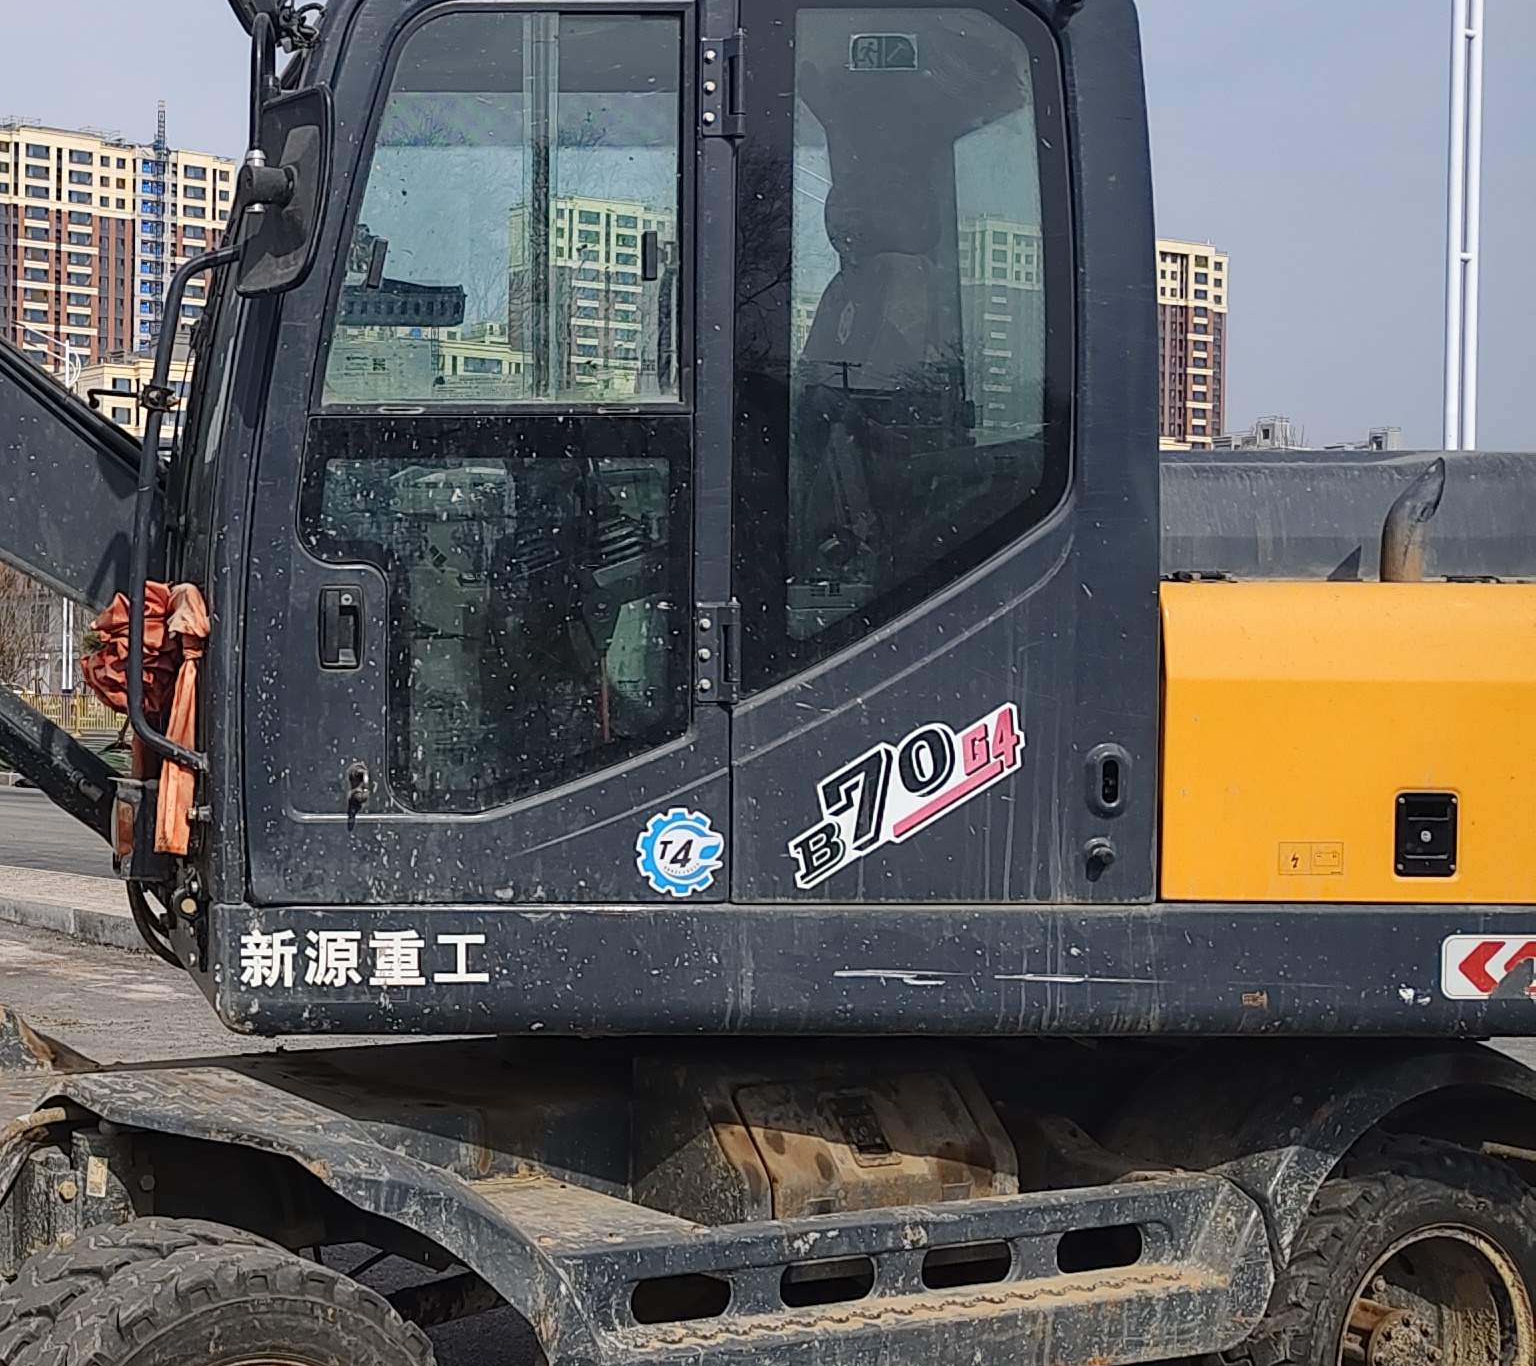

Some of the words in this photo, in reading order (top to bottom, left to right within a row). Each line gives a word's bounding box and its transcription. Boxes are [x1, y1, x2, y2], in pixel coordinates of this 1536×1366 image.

[659, 839, 693, 868] T4
[240, 929, 490, 987] 新源重工
